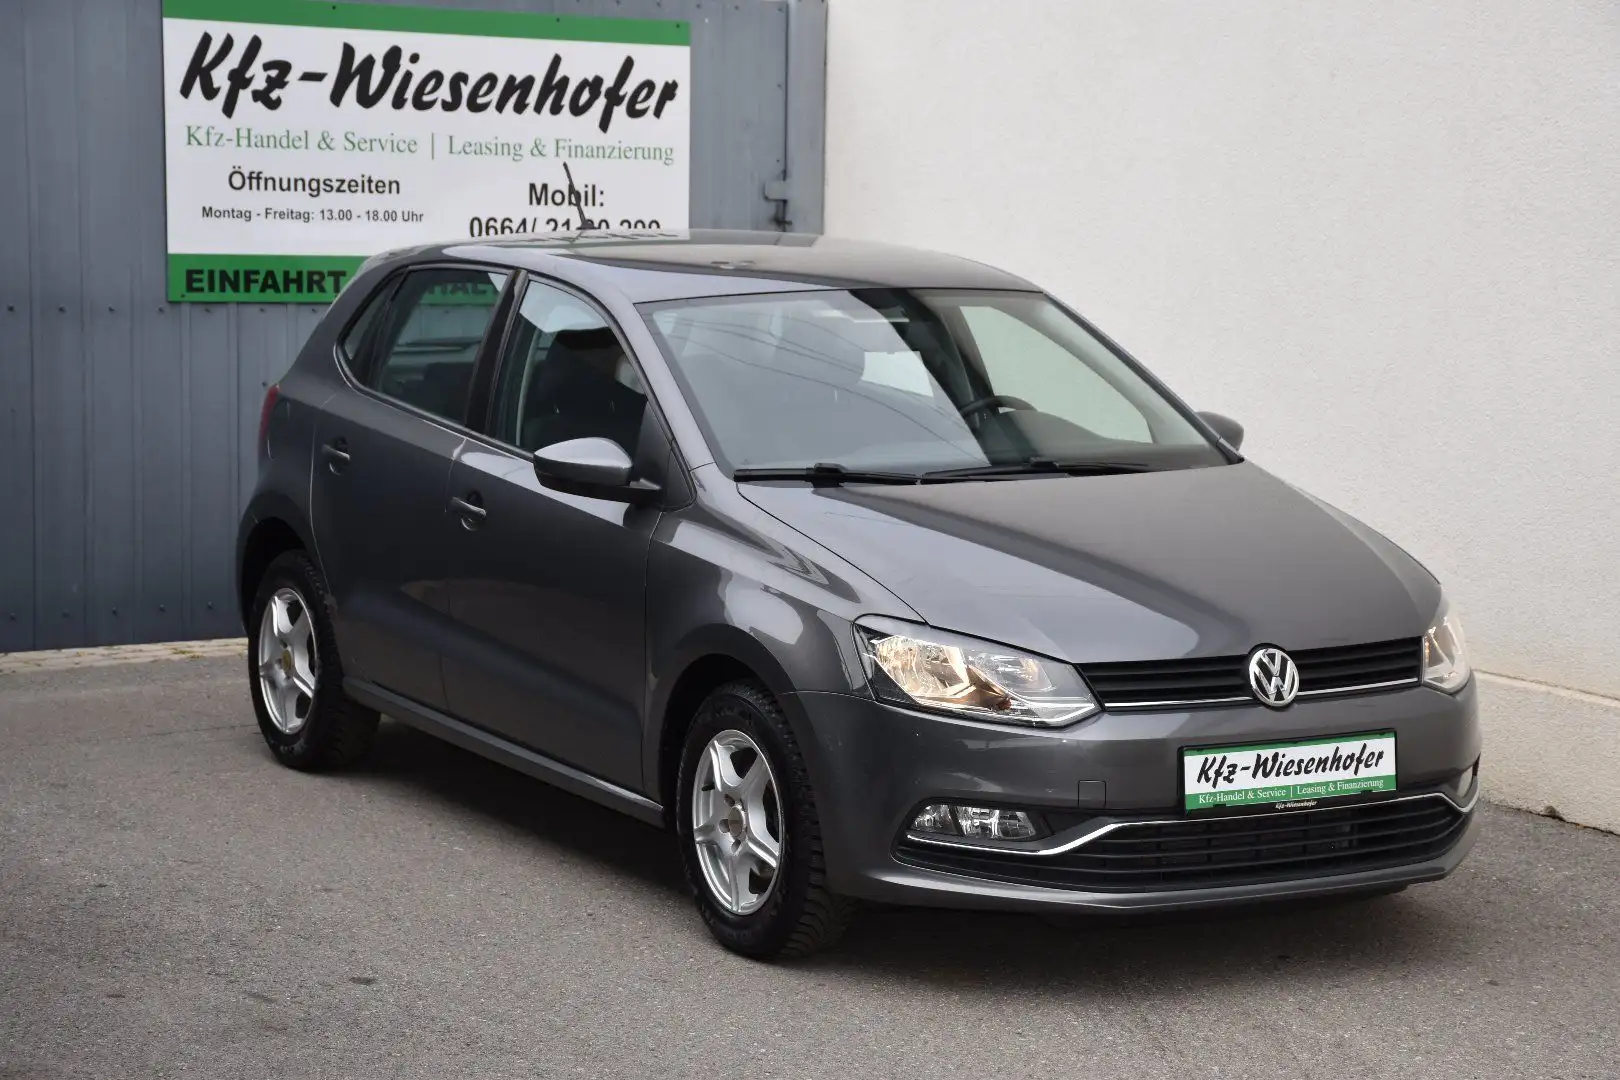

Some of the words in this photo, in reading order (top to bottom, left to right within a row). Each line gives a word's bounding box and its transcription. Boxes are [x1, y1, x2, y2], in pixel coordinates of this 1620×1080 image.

[179, 31, 679, 133] Kfz-Wiesenhofer
[186, 125, 310, 150] Kfz-Handel
[317, 130, 336, 151] &
[343, 131, 418, 154] Service
[448, 136, 524, 162] Leasing
[530, 138, 547, 159] &
[554, 140, 675, 166] Finanzierung
[228, 165, 401, 198] Öffnungszeiten
[529, 183, 605, 208] Mobil:
[201, 206, 252, 221] Montag
[264, 207, 315, 223] Freitag:
[319, 208, 353, 221] 13.00
[365, 209, 398, 222] 18.00
[401, 210, 425, 223] Uhr
[185, 269, 347, 293] EINFAHRT
[1196, 743, 1384, 789] Kfz-Wiesenhofer
[1199, 790, 1245, 804] Kfz-Handel
[1247, 789, 1255, 799] &
[1257, 787, 1287, 799] Service
[1297, 784, 1327, 795] Leasing
[1328, 782, 1336, 792] &
[1337, 779, 1384, 791] Finanzierung
